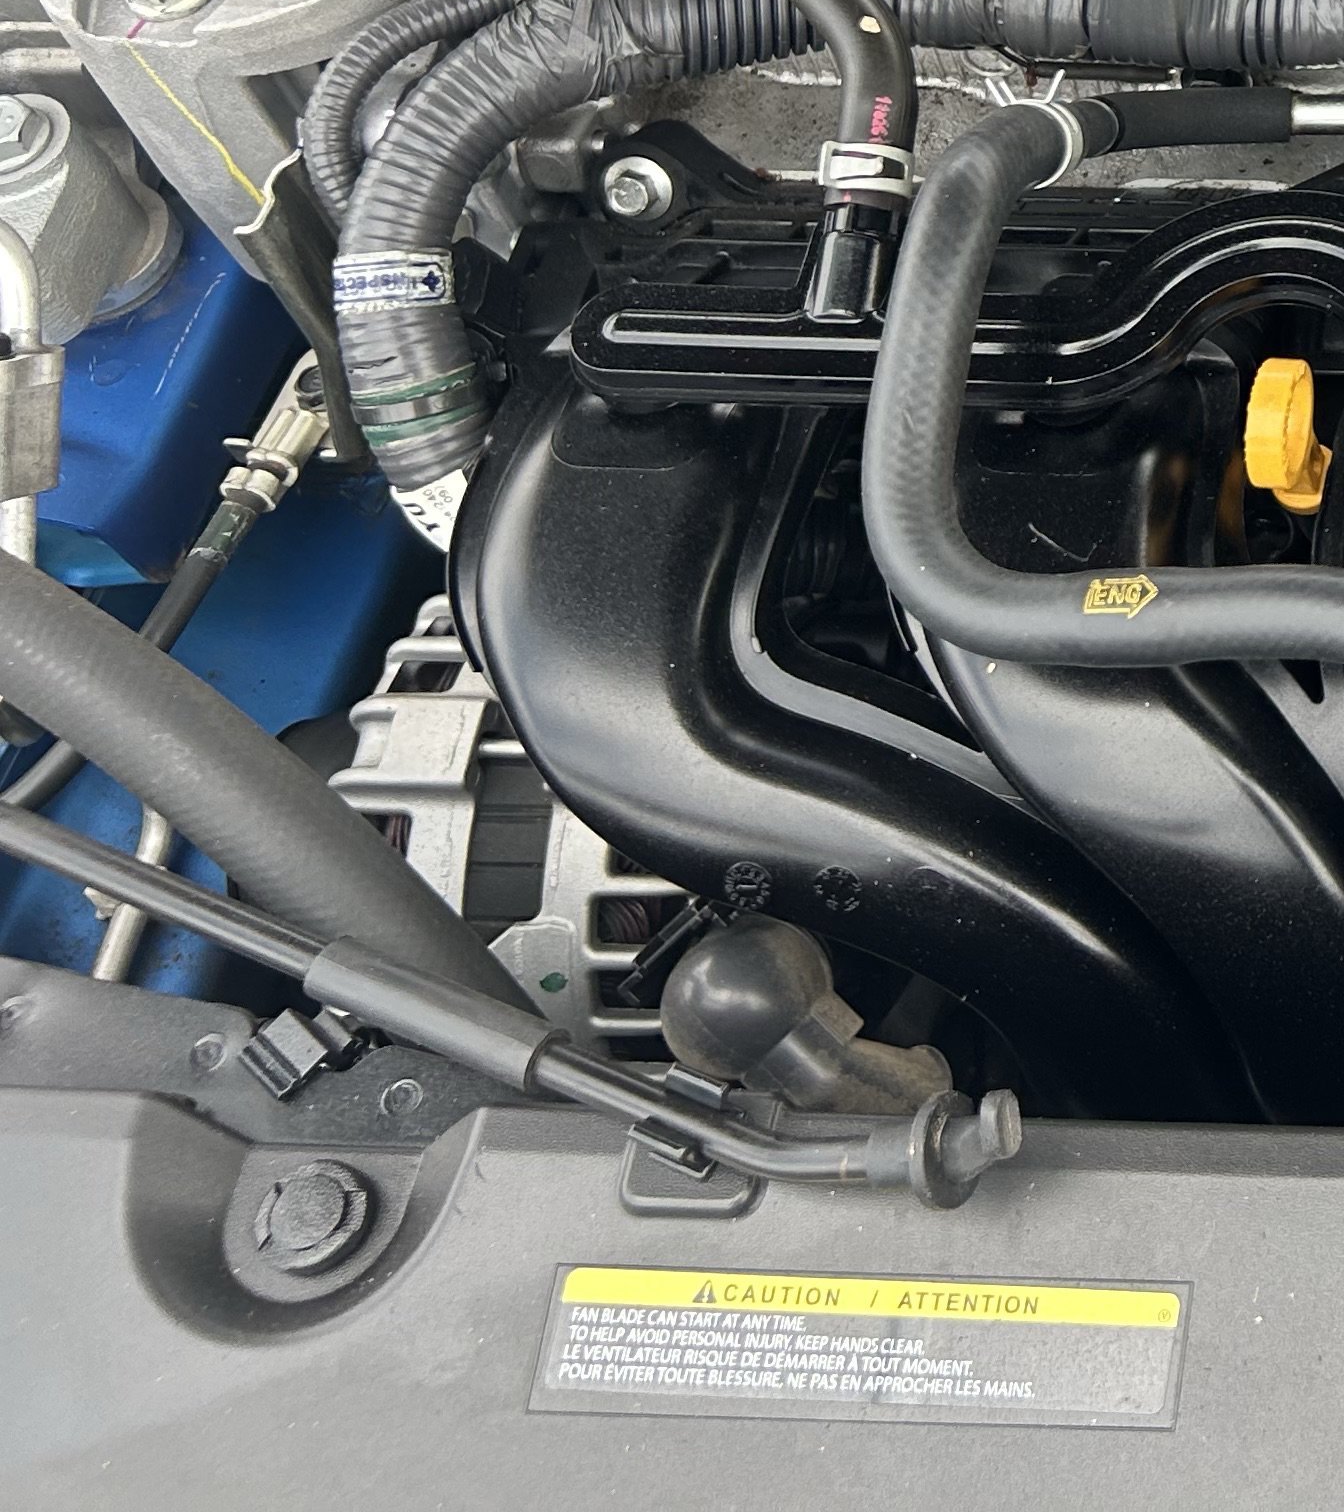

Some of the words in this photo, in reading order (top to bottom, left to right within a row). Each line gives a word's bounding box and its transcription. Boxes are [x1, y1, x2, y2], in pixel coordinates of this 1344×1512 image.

[1093, 583, 1142, 605] ENG
[723, 1284, 841, 1306] CAUTION
[870, 1289, 879, 1308] /
[898, 1291, 1039, 1314] ATTENTION
[571, 1307, 598, 1323] FAN
[601, 1308, 647, 1325] BLADE
[647, 1310, 677, 1326] CAN
[679, 1311, 722, 1328] START
[722, 1313, 740, 1328] AT
[569, 1326, 588, 1341] TO
[590, 1327, 626, 1343] HELP
[626, 1328, 670, 1344] AVOID
[672, 1330, 742, 1348] PERSONAL
[796, 1334, 829, 1351] KEEP
[830, 1335, 879, 1354] HANDS
[880, 1338, 926, 1355] CLEAR.
[563, 1344, 582, 1360] LE
[584, 1345, 681, 1365] VENTILATEUR
[683, 1349, 738, 1368] RISQUE
[740, 1351, 761, 1368] DE
[764, 1348, 845, 1370] DÉMARRER
[848, 1350, 860, 1371] À
[860, 1357, 899, 1374] TOUT
[902, 1358, 974, 1377] MOMENT.
[560, 1363, 601, 1380] POUR
[604, 1362, 654, 1382] ÉVITER
[658, 1367, 706, 1384] TOUTE
[788, 1373, 809, 1388] NE
[811, 1374, 839, 1390] PAS
[841, 1376, 862, 1390] EN
[859, 1375, 954, 1394] APPROCHER
[955, 1379, 981, 1395] LES
[984, 1380, 1037, 1398] MAINS.
